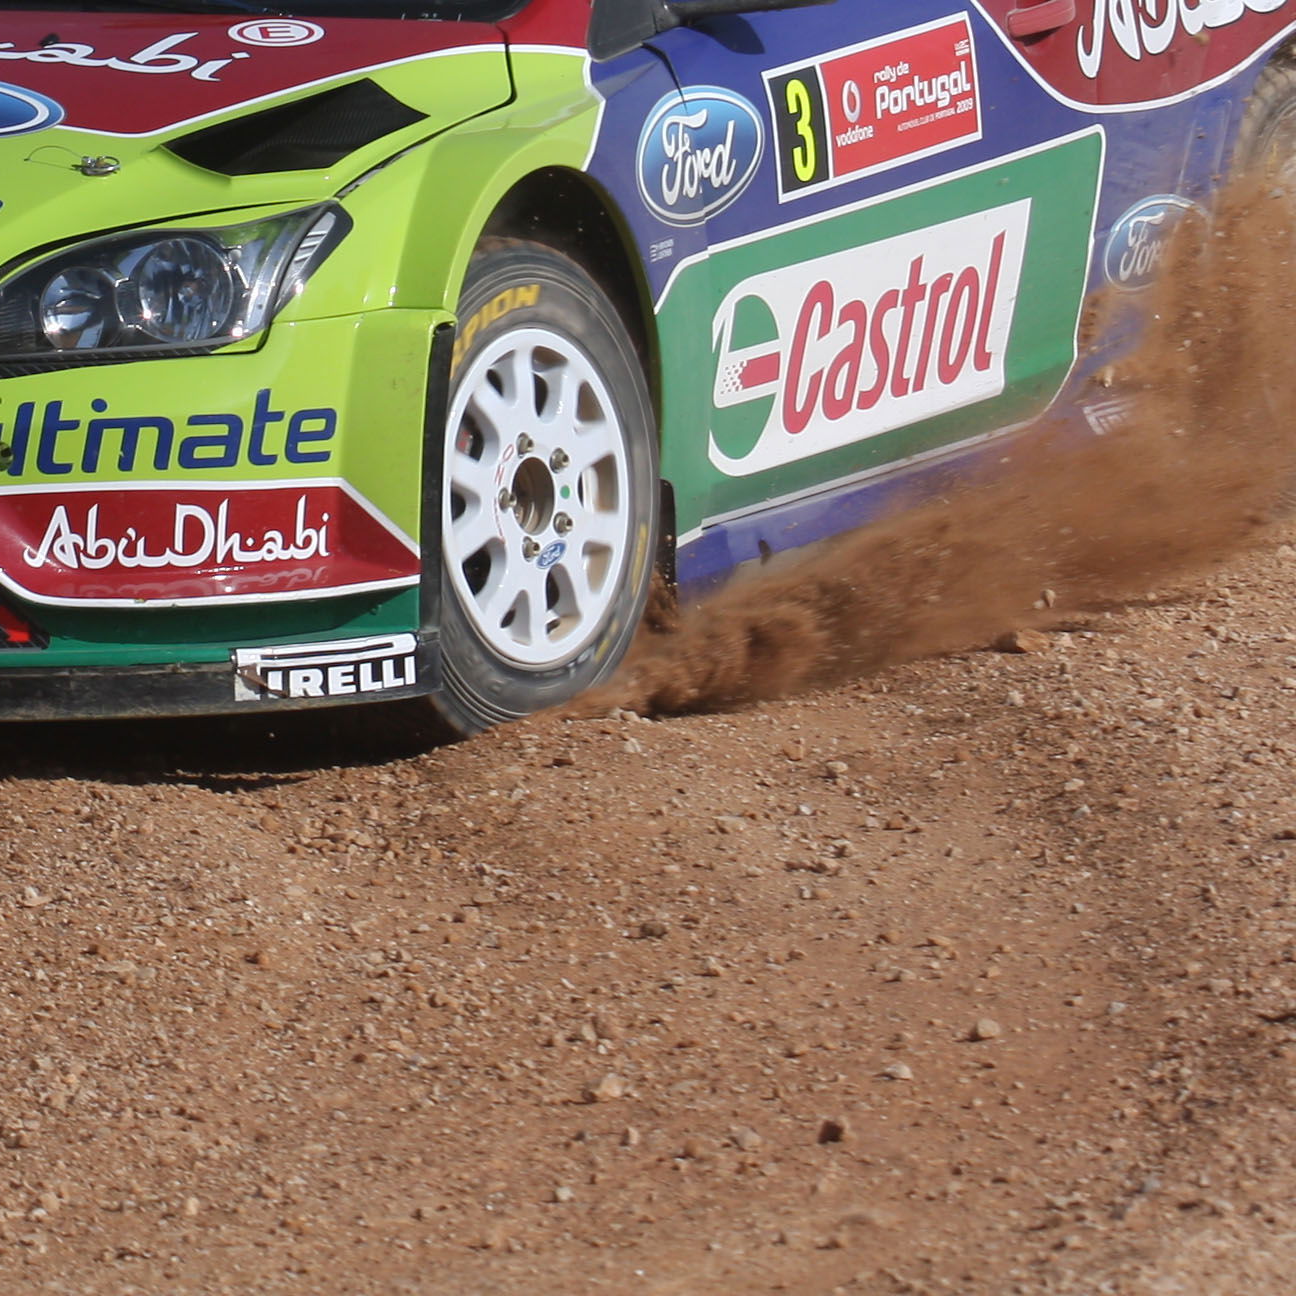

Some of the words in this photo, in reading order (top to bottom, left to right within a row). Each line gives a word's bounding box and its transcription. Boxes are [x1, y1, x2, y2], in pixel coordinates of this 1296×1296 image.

[873, 65, 897, 84] rally
[897, 61, 910, 76] de
[875, 60, 972, 119] Portugal
[661, 108, 737, 206] Ford
[786, 79, 816, 182] 3
[835, 124, 874, 147] vodafone
[782, 229, 1006, 435] Castrol
[23, 503, 172, 569] Abu
[170, 494, 332, 566] Dhabi
[234, 632, 418, 702] PIRELLI
